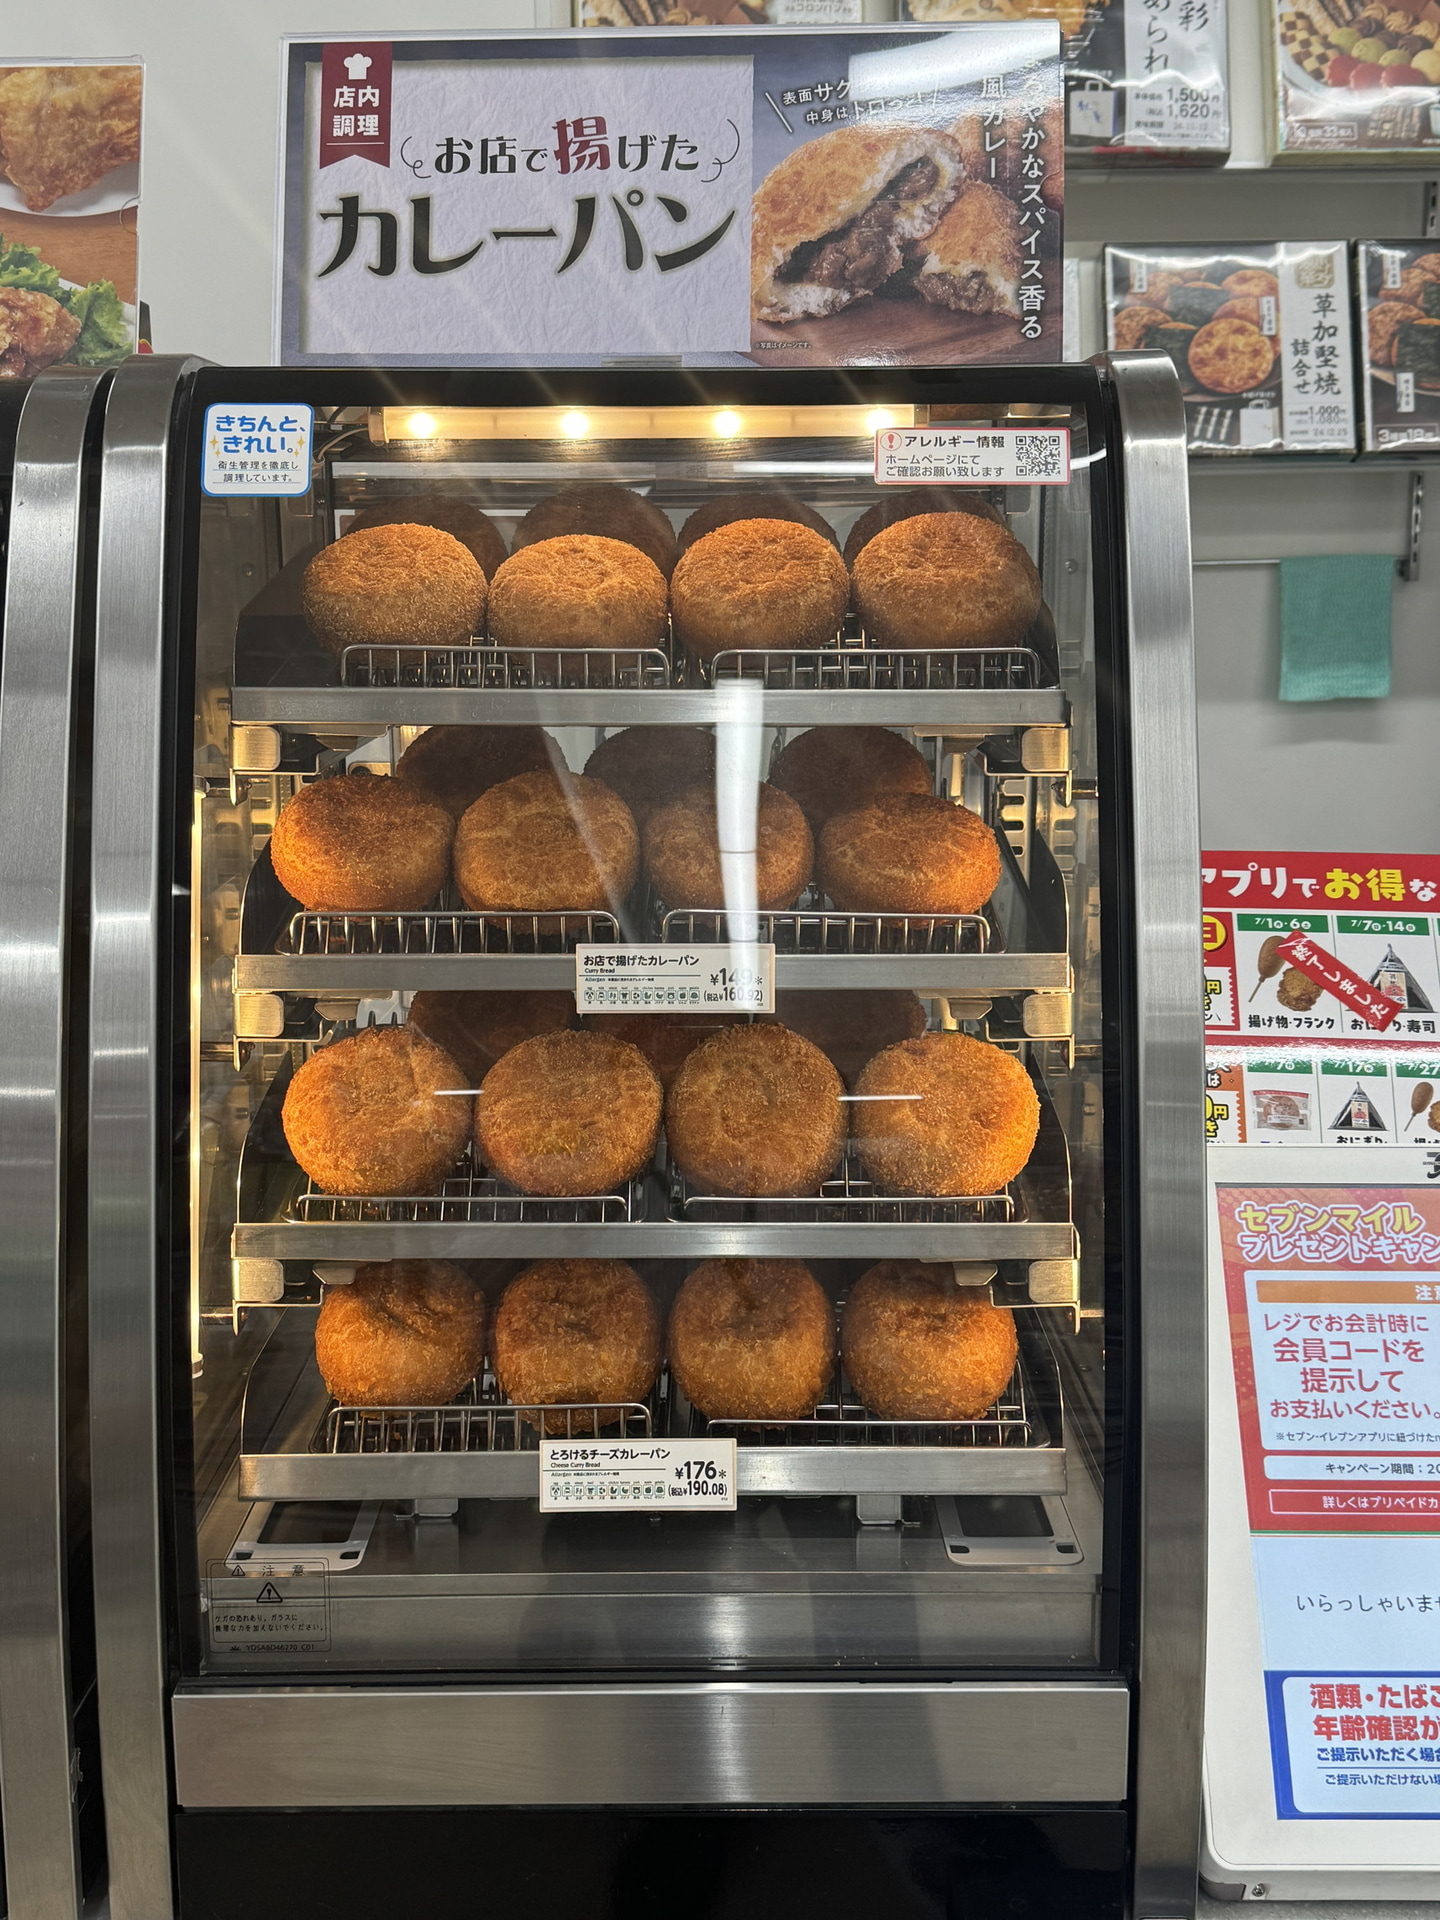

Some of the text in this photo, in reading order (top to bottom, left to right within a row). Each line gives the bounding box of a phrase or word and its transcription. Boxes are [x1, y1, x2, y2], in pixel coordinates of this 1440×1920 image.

[333, 86, 379, 108] 店内
[333, 114, 379, 137] 調理
[434, 116, 699, 174] お店で揚げた
[318, 189, 735, 278] カレーパン
[1312, 293, 1342, 395] 草加堅焼
[1290, 338, 1312, 394] 詰合せ
[216, 415, 305, 432] きちんと、
[223, 435, 294, 454] きれい。
[904, 435, 1005, 448] アレルギー情報
[218, 461, 299, 470] 衛生管理を徹底し
[886, 454, 981, 465] ホームページにて
[223, 473, 293, 482] 調理しています。
[886, 466, 1005, 477] ご確認お願い致します
[584, 955, 700, 966] お店で揚げたカレーパン
[1351, 1018, 1436, 1034] おり・寿司
[1238, 1203, 1423, 1236] セブンマイル
[1264, 1313, 1430, 1334] レジでお会計時に
[1273, 1337, 1425, 1363] 会員コードを
[1300, 1367, 1404, 1393] 提示して
[1270, 1399, 1440, 1419] お支払いください。
[550, 1448, 670, 1460] とろけるチーズカレーパン
[1322, 1495, 1439, 1508] 詳しくはプリペイドカ
